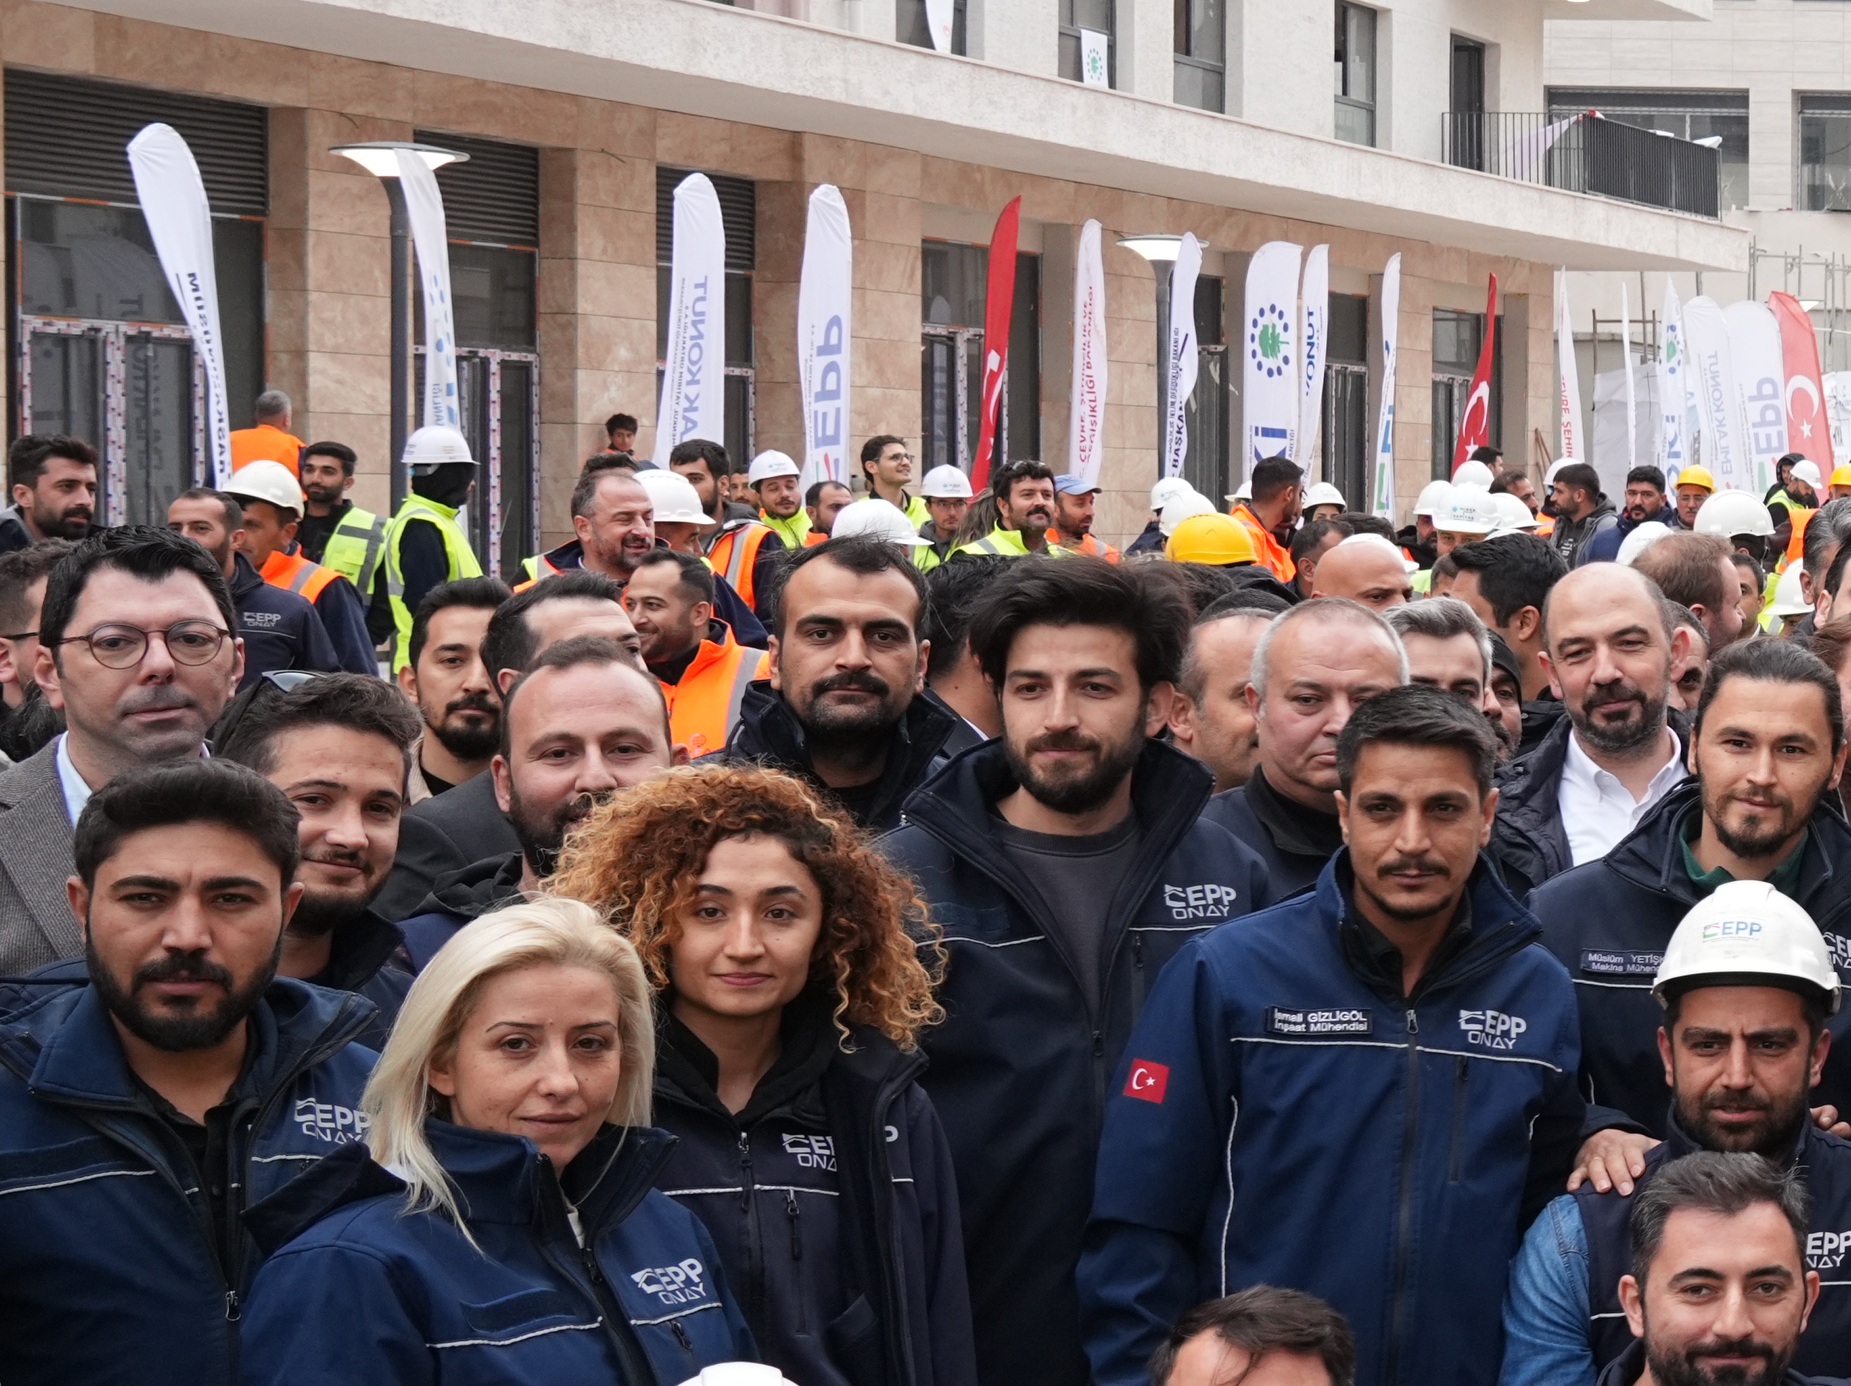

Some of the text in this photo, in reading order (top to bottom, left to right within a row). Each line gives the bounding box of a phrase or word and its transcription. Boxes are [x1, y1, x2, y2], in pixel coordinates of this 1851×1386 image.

[256, 612, 282, 623] EPP
[1188, 884, 1237, 906] EPP
[1172, 906, 1230, 920] ONAY
[1722, 921, 1762, 936] EPP
[1310, 1021, 1368, 1033] Mühendisi
[1485, 1010, 1527, 1038] EPP
[1468, 1031, 1516, 1050] ONAY
[316, 1103, 371, 1134] EPP
[798, 1153, 838, 1171] ONA
[1805, 1254, 1846, 1269] NAY
[654, 1258, 703, 1292] EPP
[658, 1283, 707, 1305] ONAY
